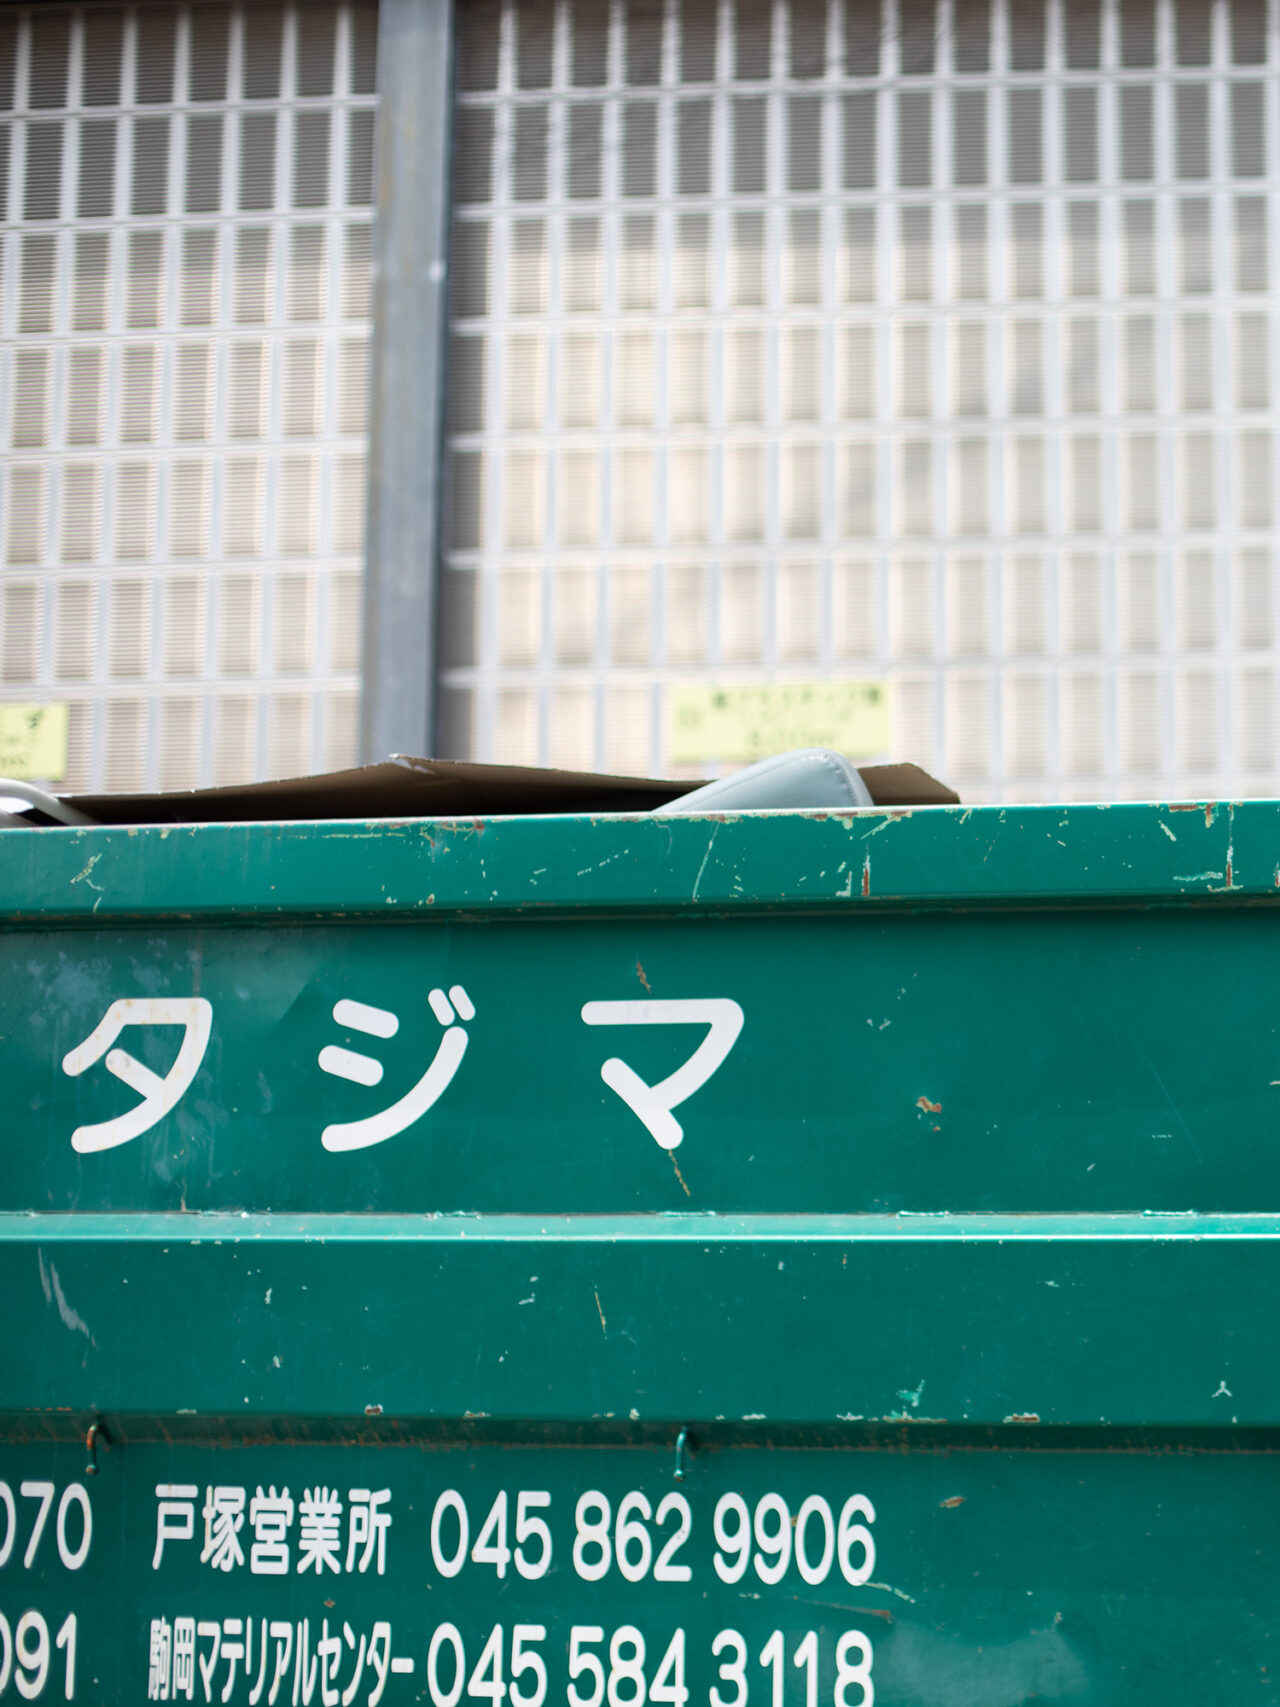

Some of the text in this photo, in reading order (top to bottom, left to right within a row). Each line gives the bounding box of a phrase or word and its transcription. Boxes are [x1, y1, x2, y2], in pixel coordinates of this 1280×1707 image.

[61, 985, 745, 1154] タジマ
[152, 1484, 877, 1587] 戸塚営業所 045 862 9906
[148, 1615, 875, 1707] 駒岡マテリアルセンター 045 584 3118
